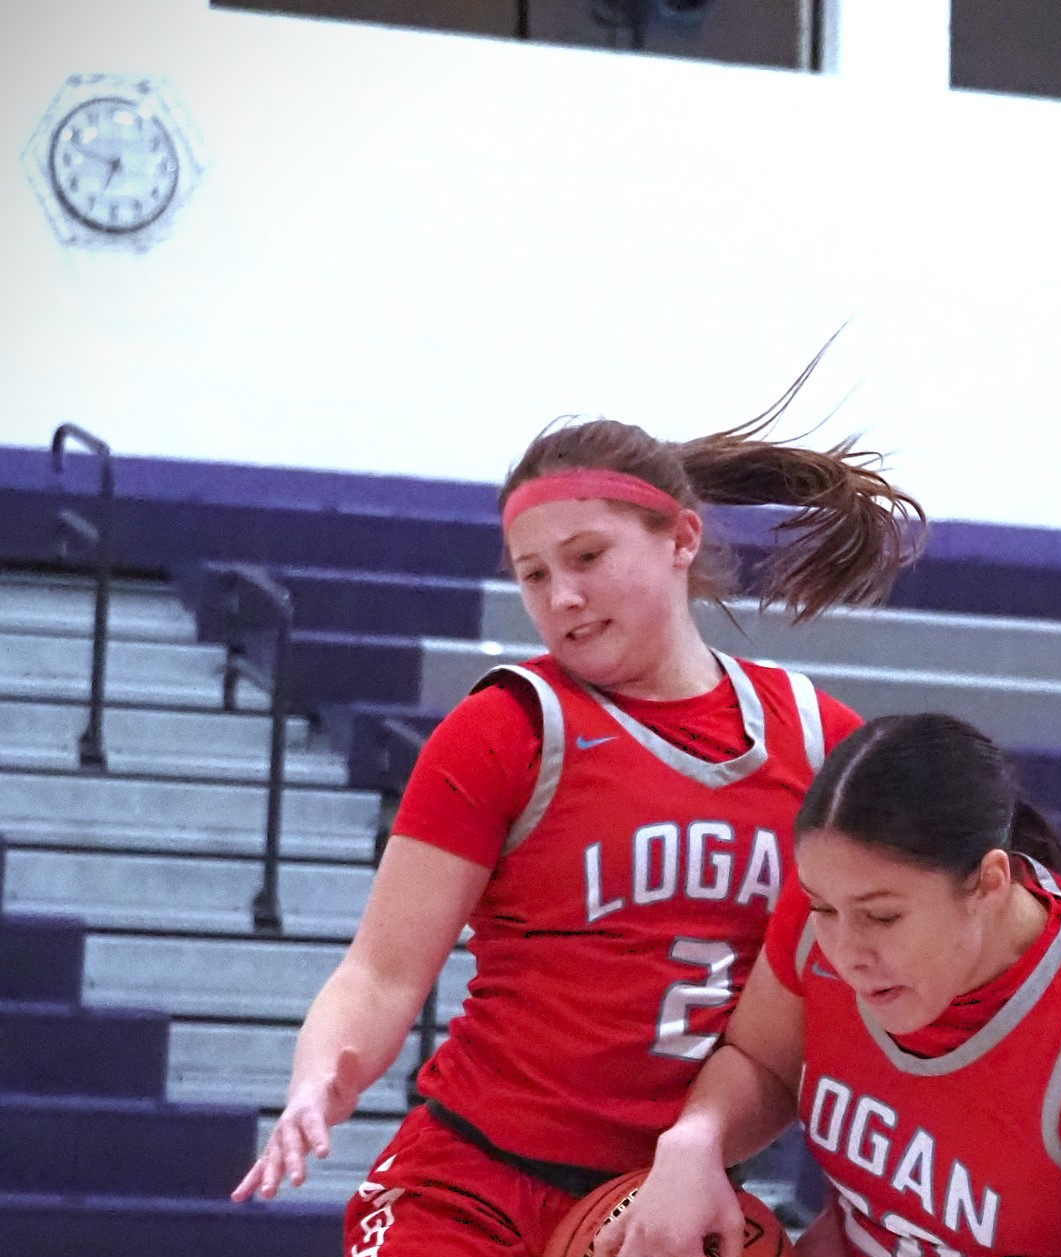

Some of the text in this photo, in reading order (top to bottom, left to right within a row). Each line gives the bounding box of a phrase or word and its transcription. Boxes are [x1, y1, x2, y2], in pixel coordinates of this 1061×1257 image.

[584, 819, 783, 924] LOGA
[648, 936, 737, 1061] 2
[808, 1075, 1001, 1249] OGAN
